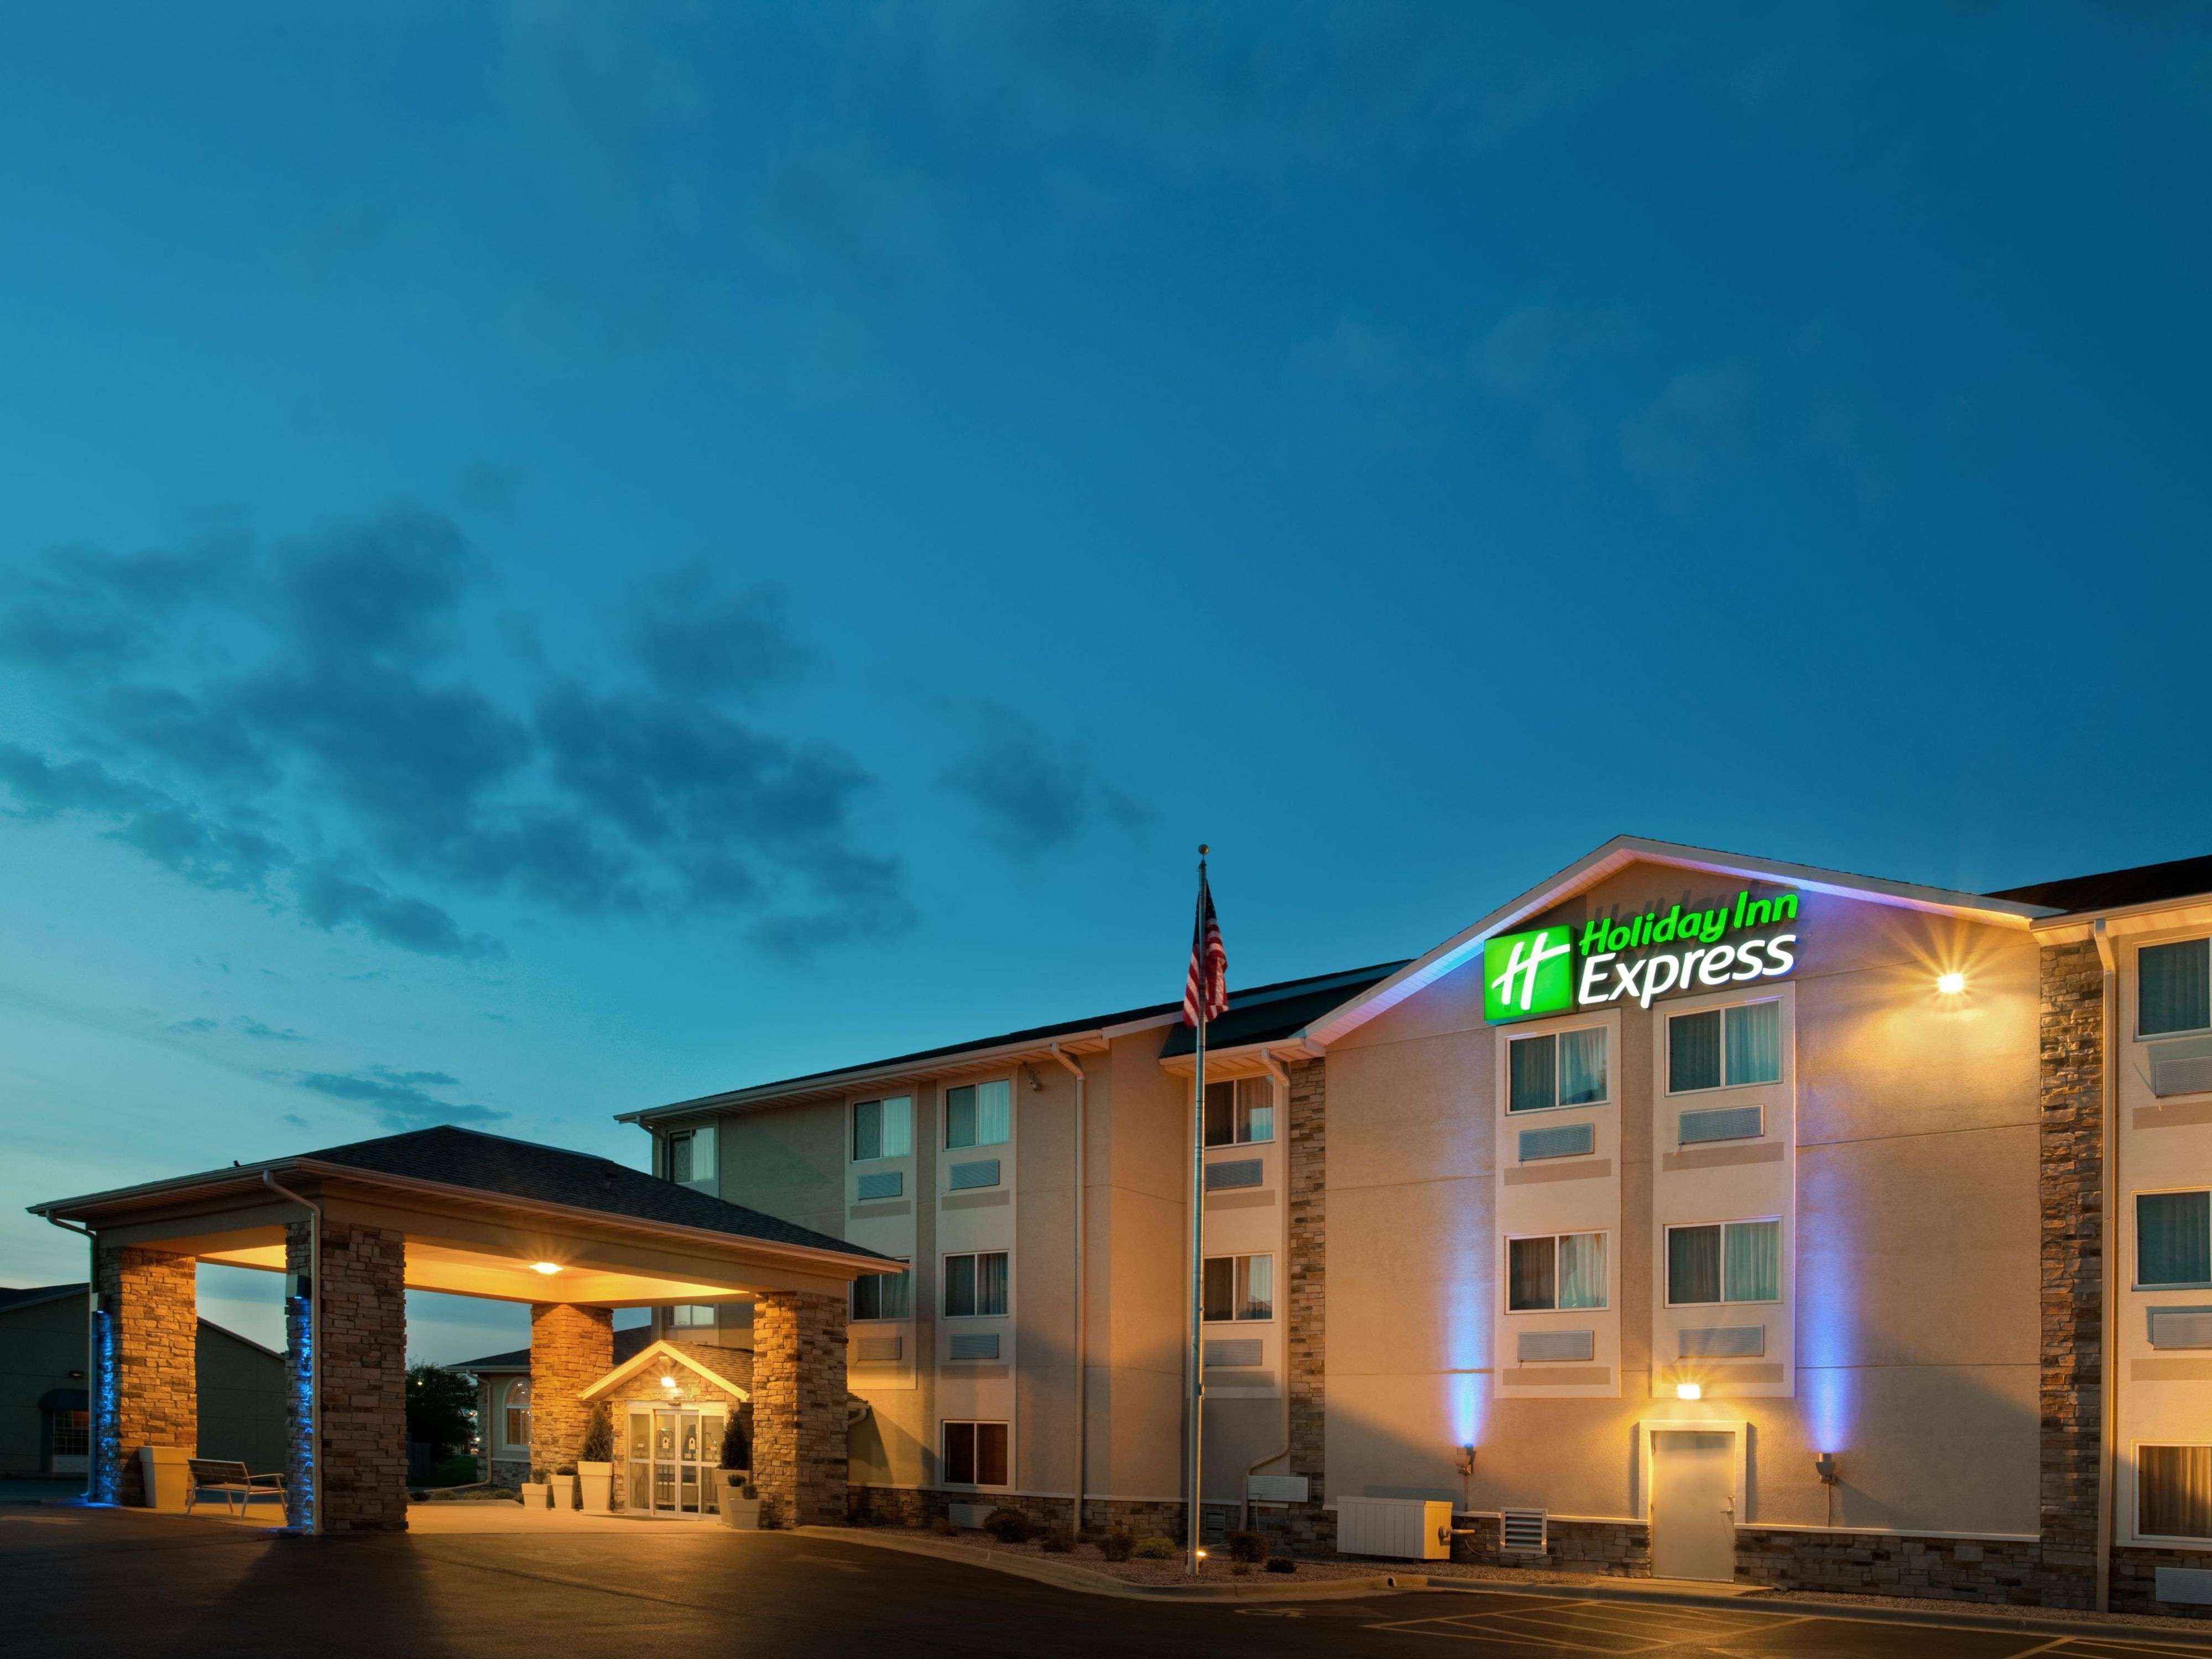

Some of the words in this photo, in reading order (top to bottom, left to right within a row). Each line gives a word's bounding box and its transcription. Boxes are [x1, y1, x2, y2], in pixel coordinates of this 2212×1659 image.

[1579, 905, 1729, 956] Holiday
[1733, 890, 1799, 928] Inn
[1578, 933, 1797, 1009] Express
